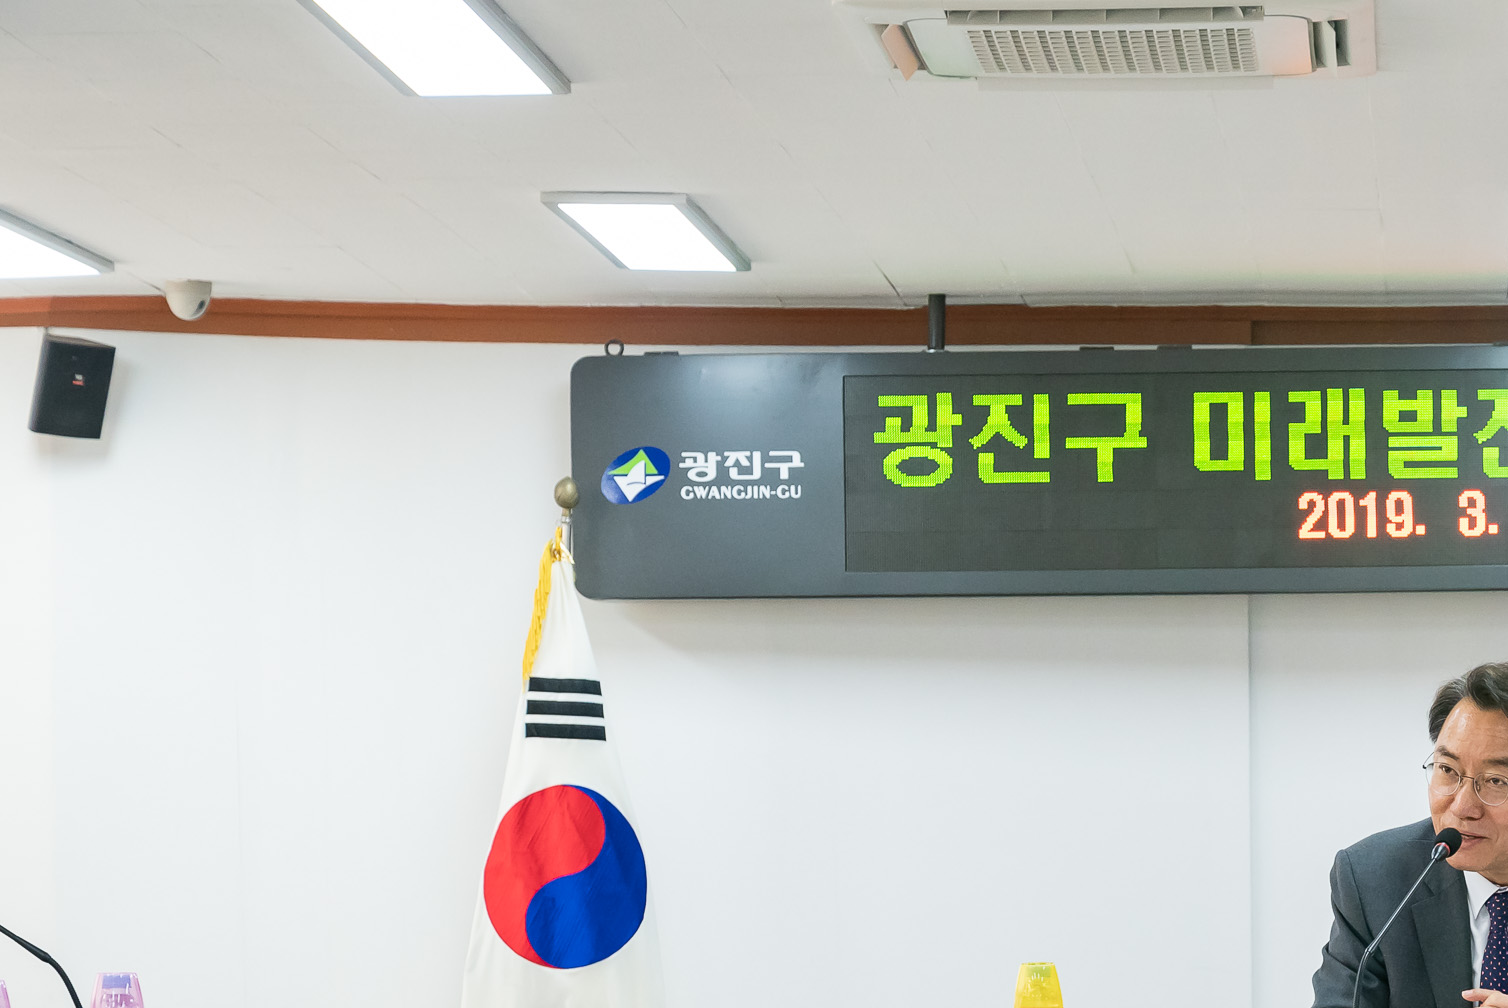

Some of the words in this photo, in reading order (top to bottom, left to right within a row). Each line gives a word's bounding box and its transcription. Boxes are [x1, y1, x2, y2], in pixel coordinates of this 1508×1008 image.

[873, 391, 1148, 487] 광진구
[678, 450, 805, 482] 광진구
[680, 484, 802, 501] GWANGJIN-GU
[1297, 490, 1427, 539] 2019.
[1457, 489, 1500, 538] 3.
